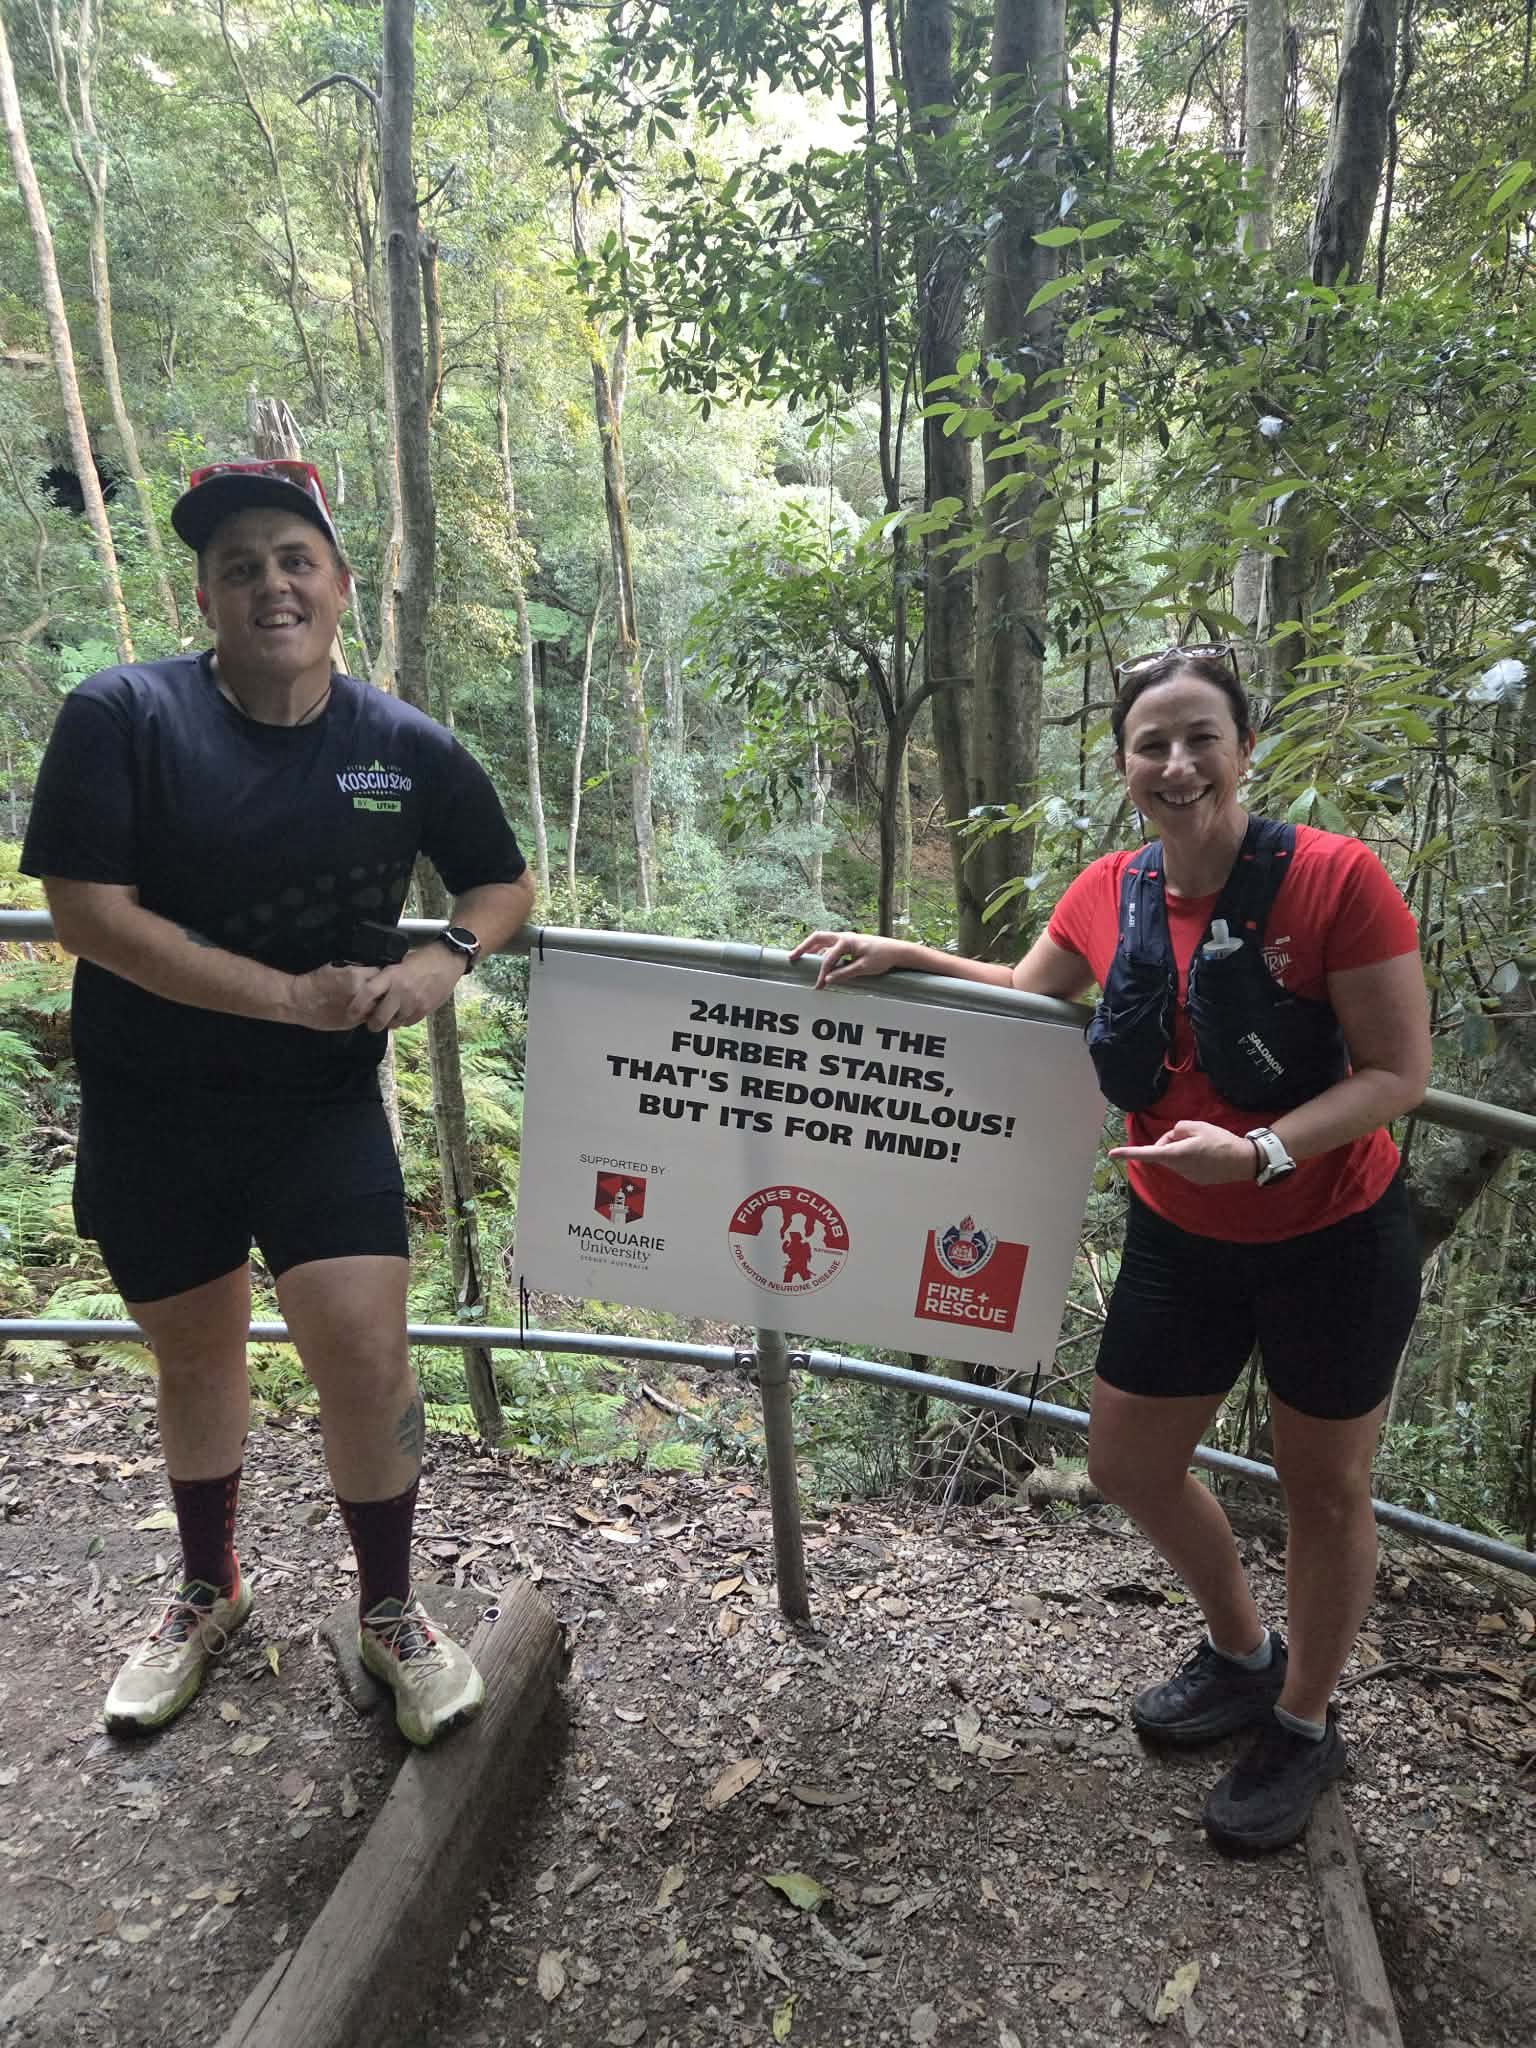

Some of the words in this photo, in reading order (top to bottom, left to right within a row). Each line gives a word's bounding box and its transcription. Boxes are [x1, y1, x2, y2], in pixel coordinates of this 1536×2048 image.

[336, 772, 412, 792] KOSCIUSZKO
[689, 1000, 799, 1036] 24HRS
[811, 1018, 864, 1046] ON
[876, 1027, 947, 1058] THE
[671, 1031, 807, 1072] FURBER
[819, 1055, 954, 1097] STAIRS,
[1247, 1032, 1285, 1076] SALOMON
[607, 1055, 729, 1093] THAT'S
[740, 1076, 1016, 1138] REDONKULOUS!
[639, 1093, 708, 1122] BUT
[719, 1106, 773, 1133] ITS
[784, 1116, 853, 1146] FOR
[864, 1129, 961, 1164] MND!
[579, 1154, 648, 1172] SUPPORTED
[651, 1165, 666, 1175] BY
[736, 1189, 791, 1224] FIRIES
[796, 1191, 844, 1238] CLIMB
[568, 1224, 665, 1251] MACQUARIE
[580, 1240, 650, 1264] University
[741, 1261, 767, 1286] MOTOR
[927, 1282, 975, 1302] FIRE
[924, 1297, 1008, 1323] RESCUE
